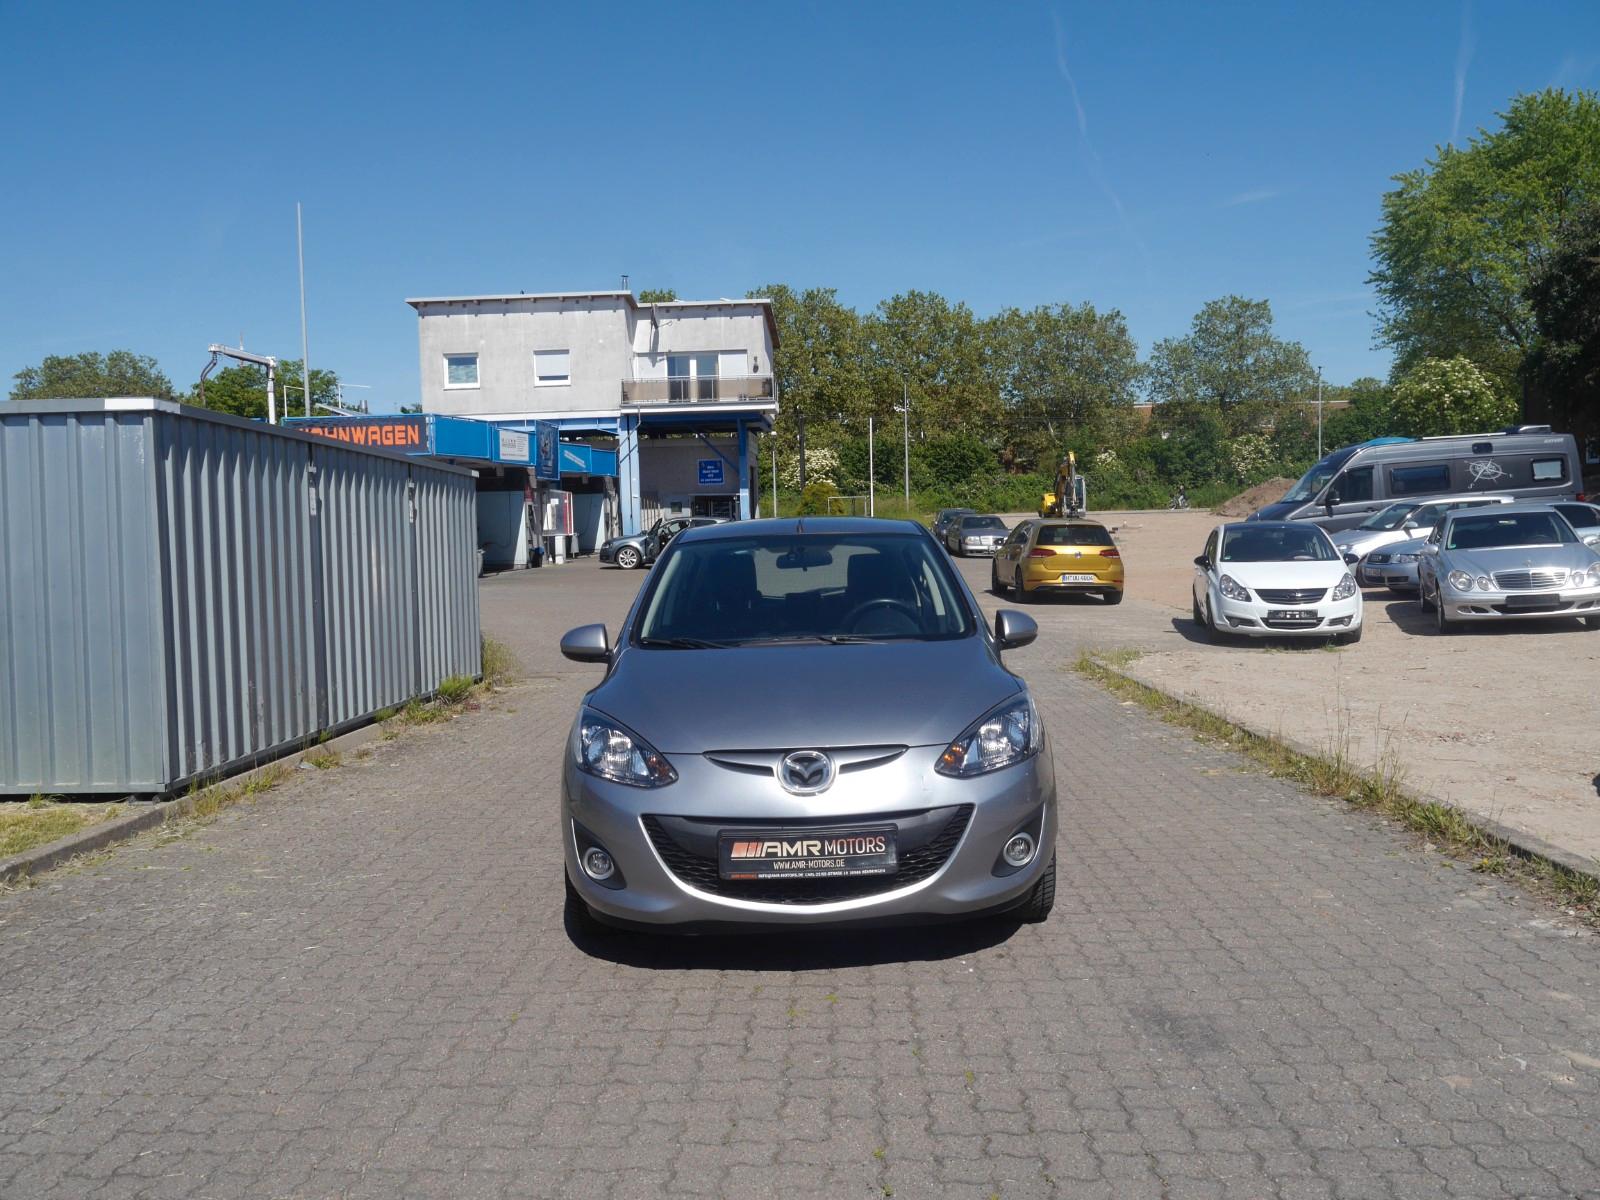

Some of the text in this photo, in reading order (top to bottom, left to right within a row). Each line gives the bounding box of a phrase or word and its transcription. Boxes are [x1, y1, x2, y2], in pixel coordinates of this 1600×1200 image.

[299, 424, 419, 446] HNWAGEN
[761, 837, 886, 857] AMR MOTORS
[773, 859, 845, 870] WWW.AMR-MOTORS.DE
